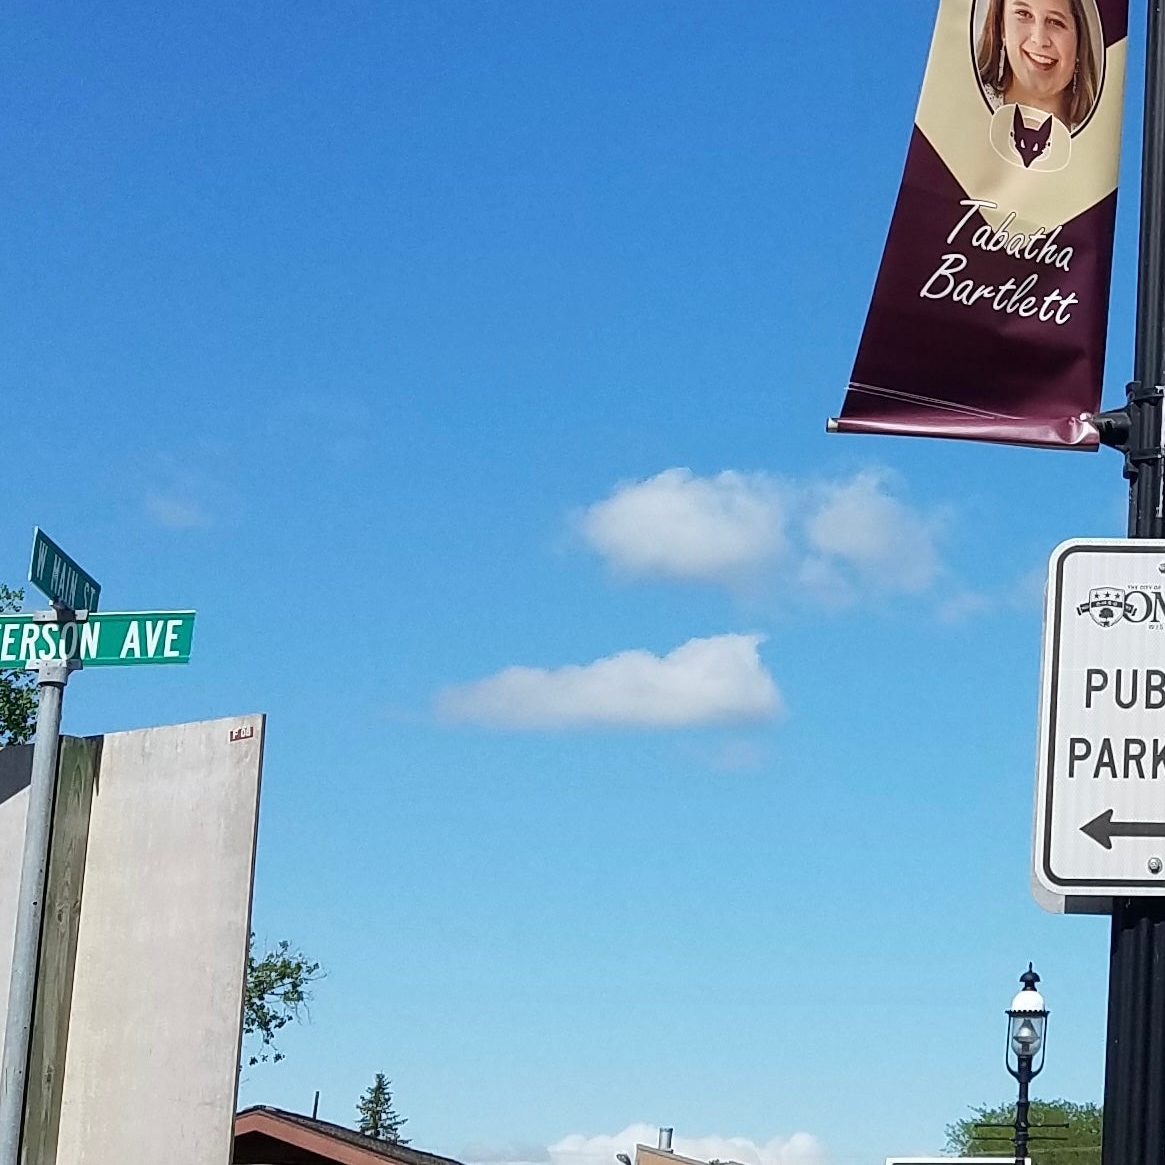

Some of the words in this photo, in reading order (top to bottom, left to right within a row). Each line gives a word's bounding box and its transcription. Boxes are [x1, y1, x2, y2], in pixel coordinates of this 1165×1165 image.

[947, 199, 1074, 271] Tabatha
[920, 253, 1079, 325] Bartlett
[36, 540, 49, 581] W
[50, 553, 79, 612] MAIN
[83, 581, 96, 612] ST
[0, 621, 101, 661] ERSON
[119, 620, 183, 658] AVE
